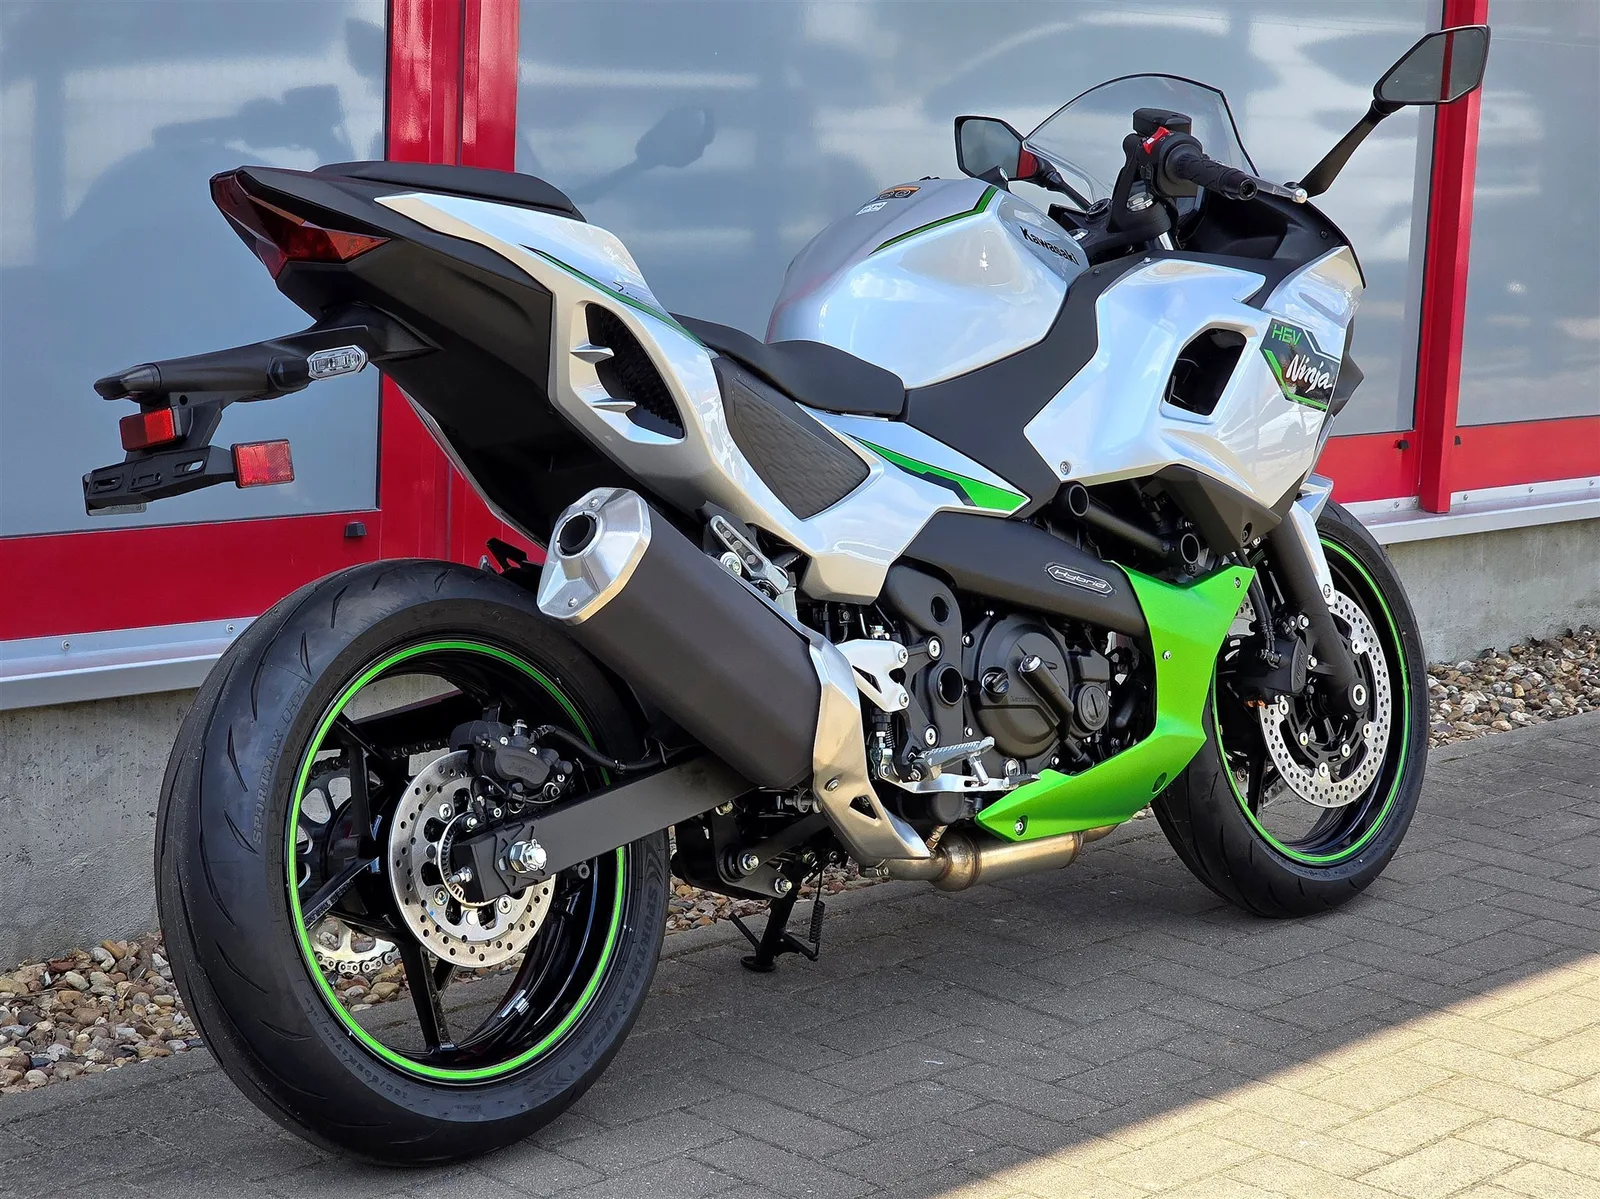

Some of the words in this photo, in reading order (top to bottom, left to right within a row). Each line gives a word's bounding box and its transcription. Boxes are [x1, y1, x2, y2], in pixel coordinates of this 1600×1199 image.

[1019, 224, 1080, 266] Kawasaki
[1271, 323, 1302, 345] HEV
[1285, 354, 1333, 394] Ninja
[1054, 569, 1107, 589] Hybrid
[252, 729, 283, 844] SPORTMAX
